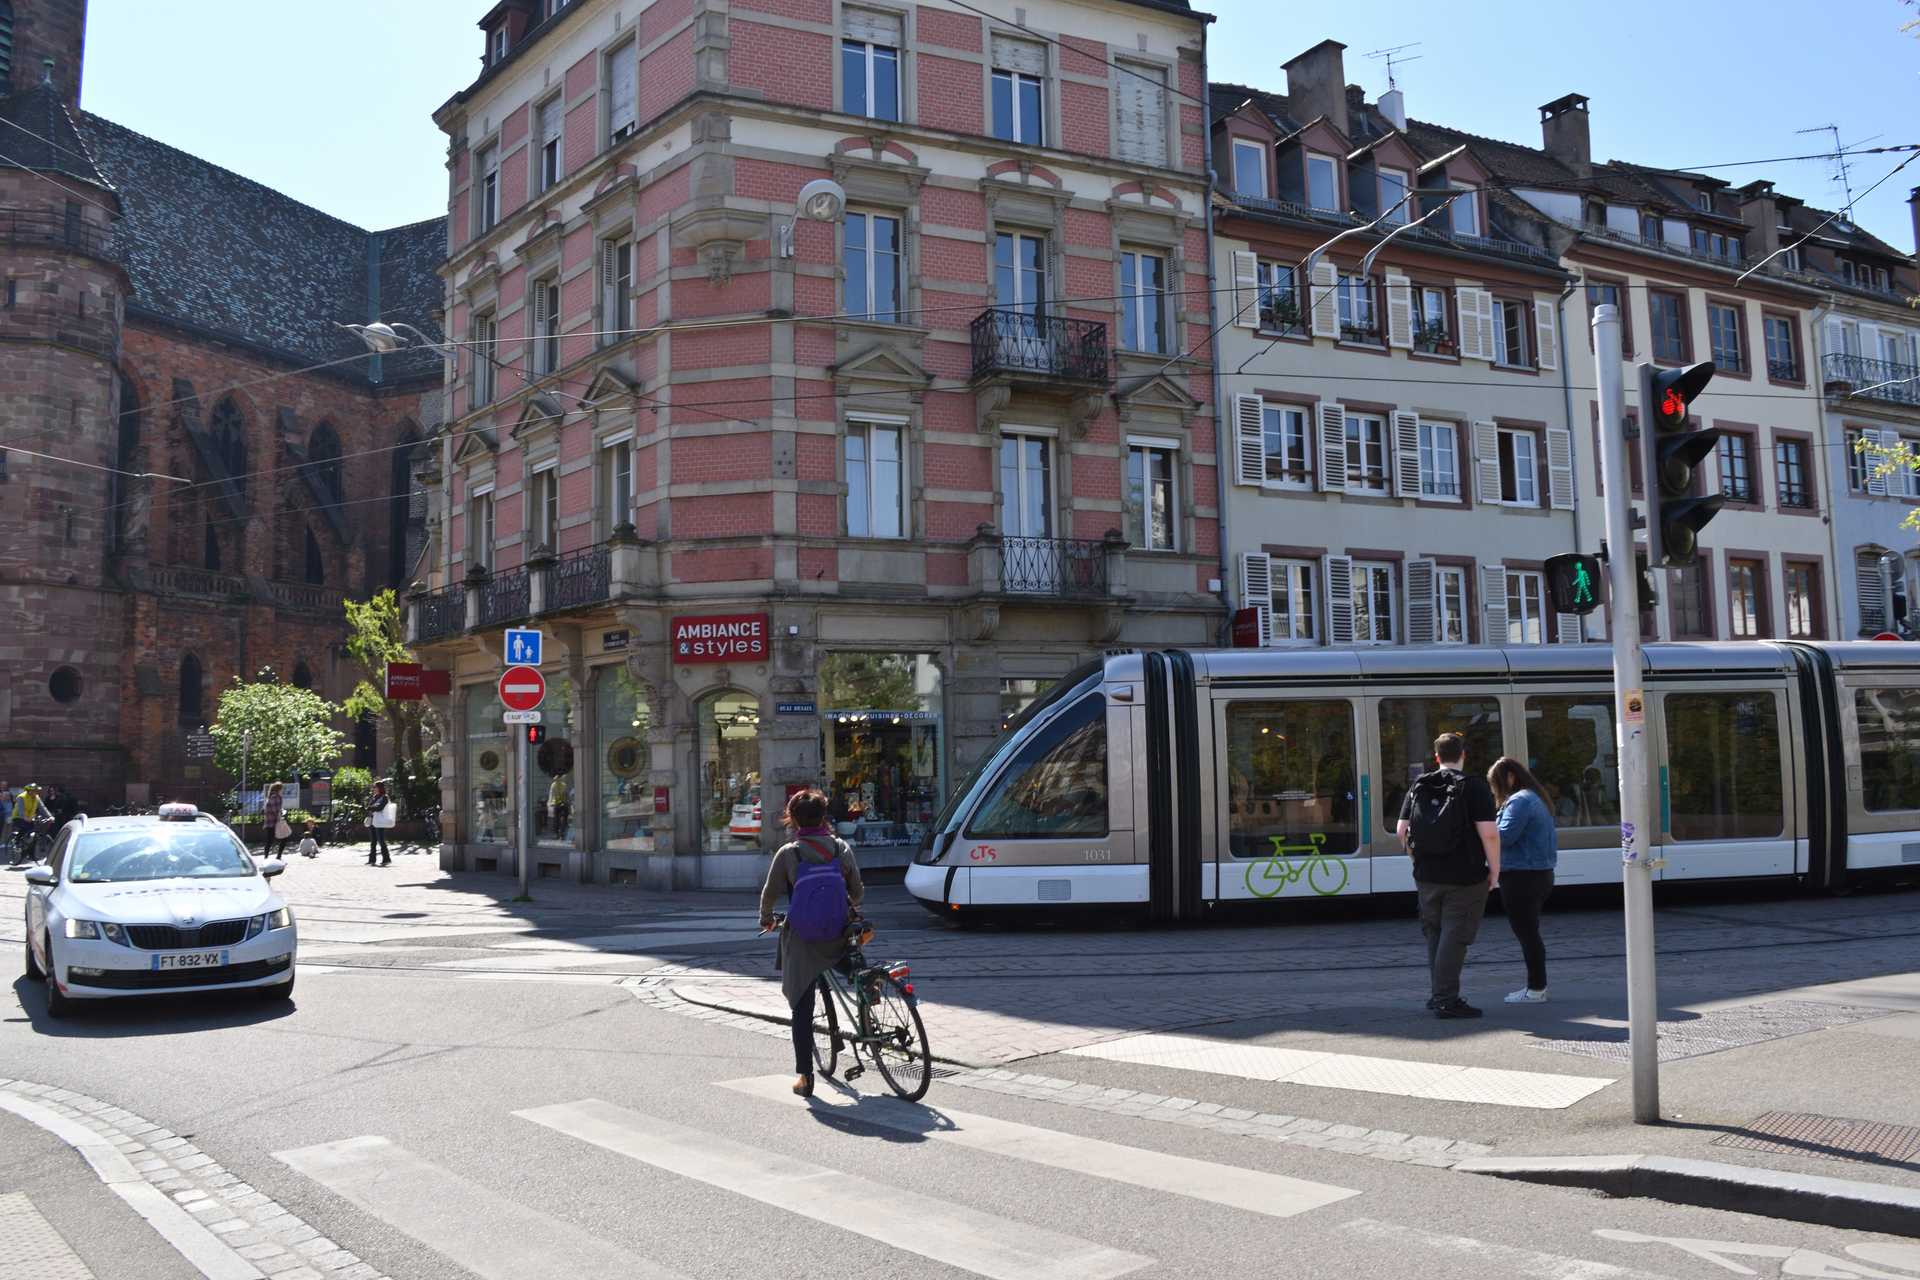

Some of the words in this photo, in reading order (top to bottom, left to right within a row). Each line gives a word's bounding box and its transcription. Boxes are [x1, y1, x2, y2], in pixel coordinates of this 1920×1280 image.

[676, 622, 761, 639] AMBIANCE
[680, 642, 689, 654] &
[693, 640, 762, 656] styles
[1085, 848, 1111, 861] 1031
